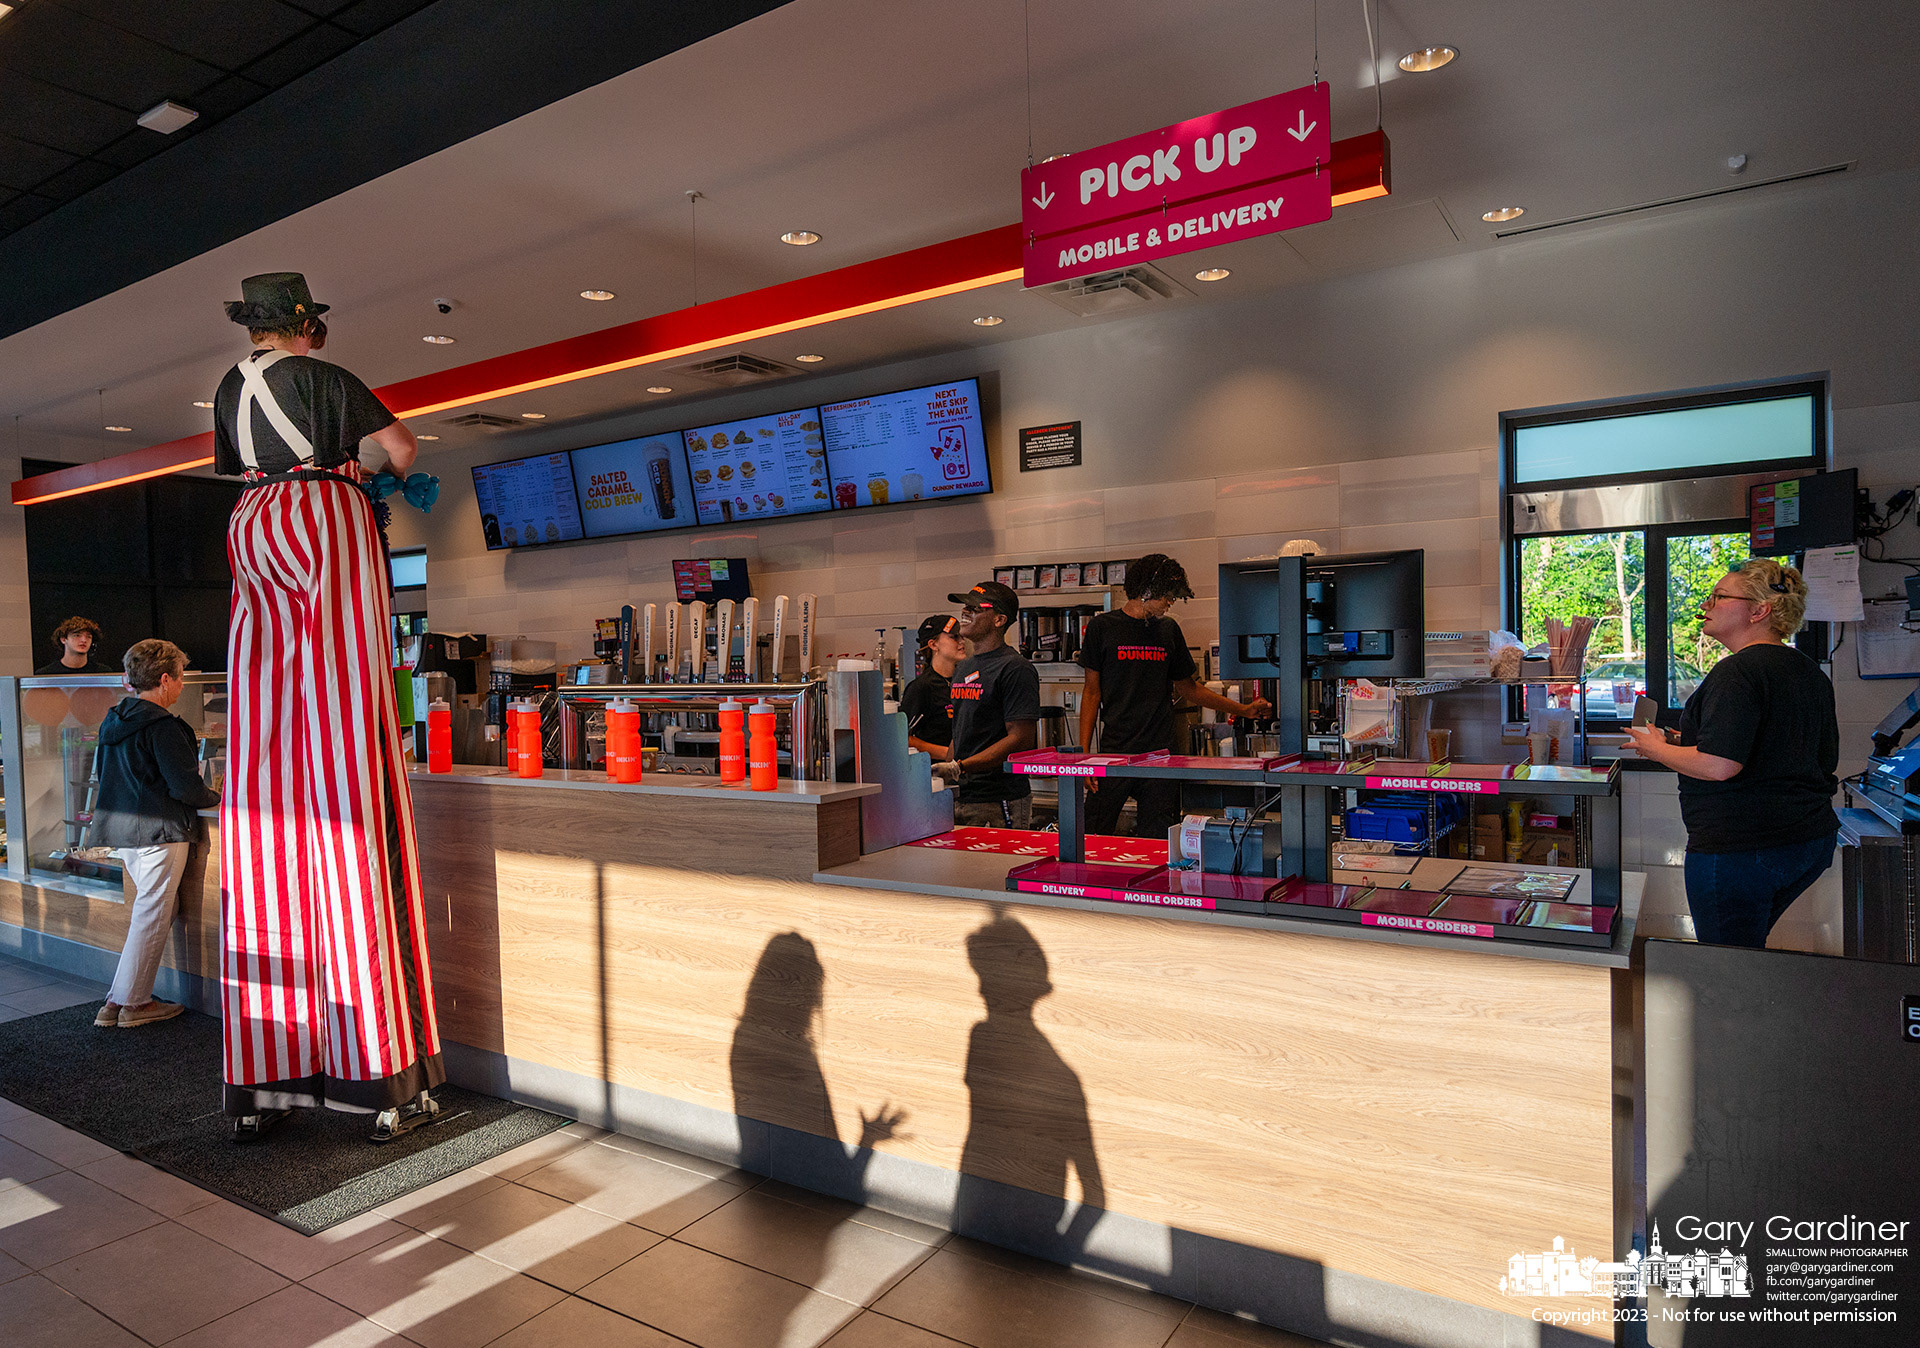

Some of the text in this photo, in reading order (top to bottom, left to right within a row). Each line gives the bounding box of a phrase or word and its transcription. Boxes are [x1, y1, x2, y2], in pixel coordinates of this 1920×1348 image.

[1080, 125, 1257, 205] PICK UP
[1058, 197, 1284, 268] MOBILE & DELIVERY
[935, 388, 957, 399] NEXT
[823, 401, 857, 413] REFRESHING
[927, 397, 968, 410] TIME SKIP
[777, 413, 801, 422] ALL-DAY
[928, 406, 969, 420] THE WAIT
[590, 470, 627, 486] SALTED
[587, 482, 635, 498] CARAMEL
[955, 480, 984, 490] REWARDS
[584, 492, 642, 510] COLD BREW
[1117, 650, 1168, 661] DUNKIN'
[950, 688, 984, 701] DUNKIN'
[1023, 764, 1095, 776] MOBILE ORDERS
[1381, 778, 1482, 792] MOBILE ORDERS
[1042, 884, 1085, 896] DELIVERY
[1124, 893, 1203, 907] MOBILE ORDERS
[1377, 915, 1477, 934] MOBILE ORDERS
